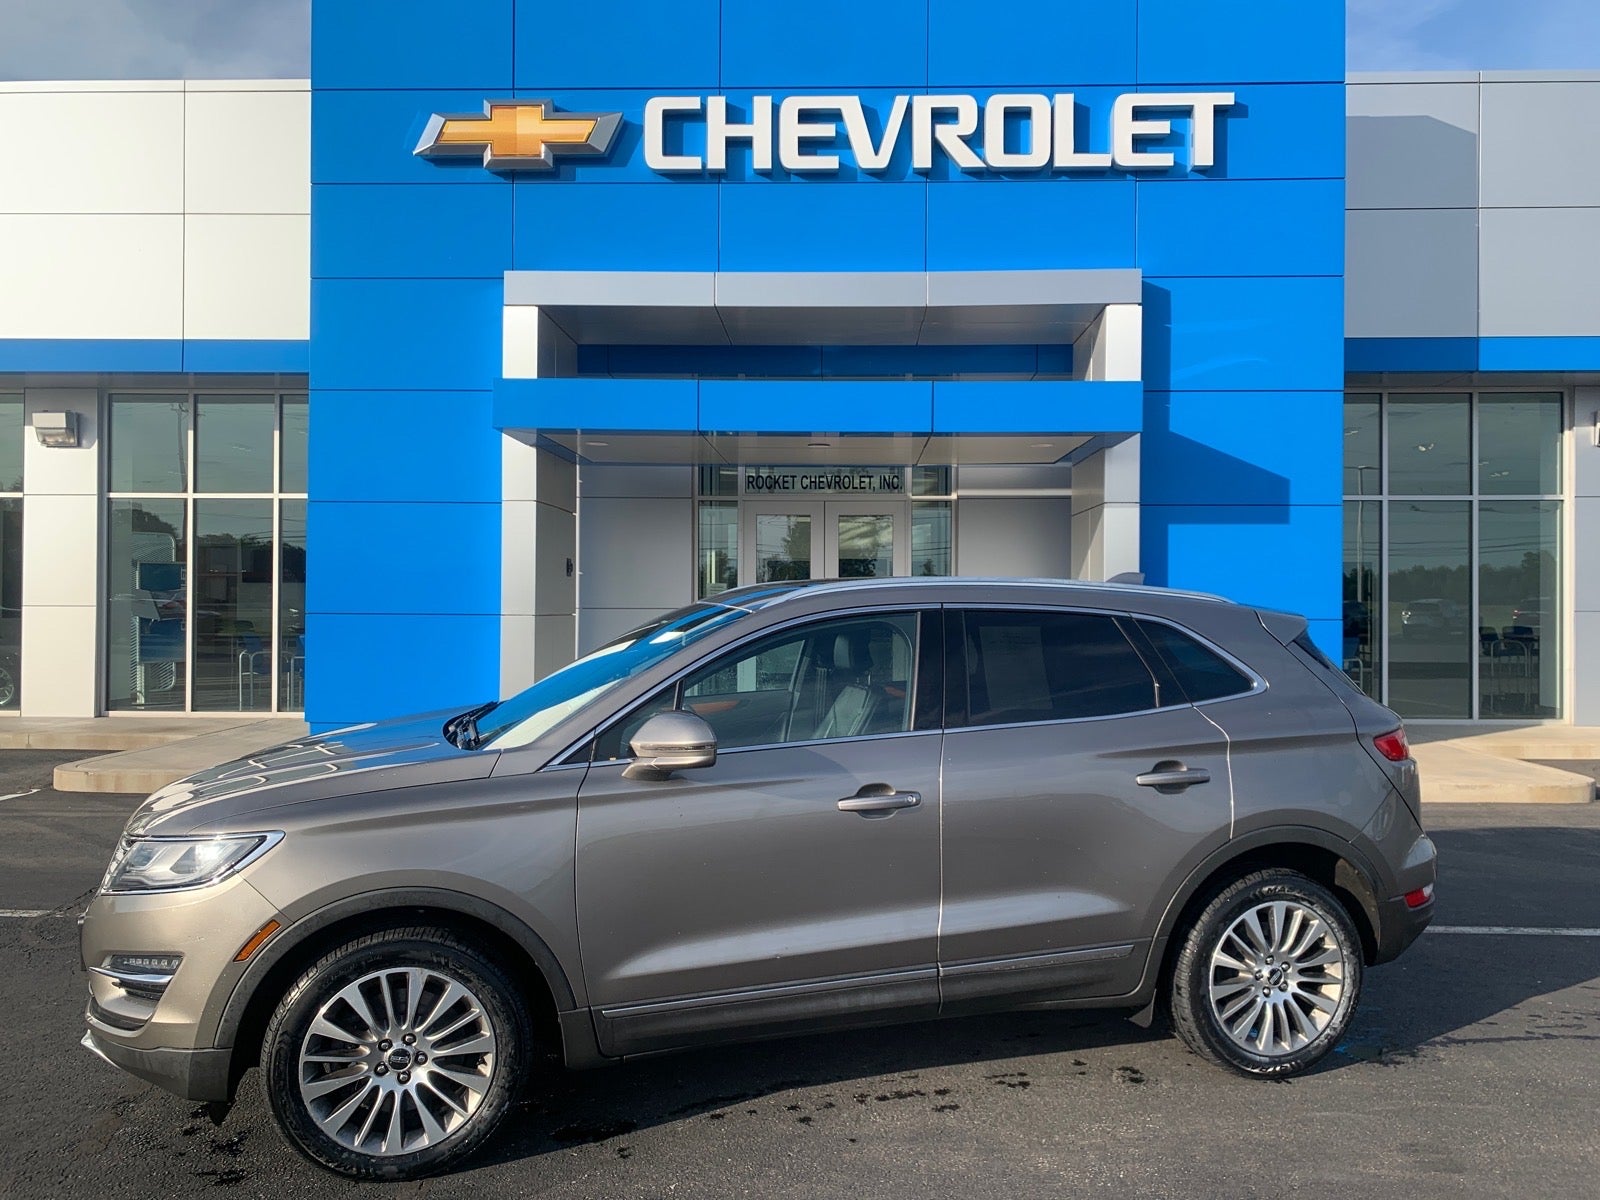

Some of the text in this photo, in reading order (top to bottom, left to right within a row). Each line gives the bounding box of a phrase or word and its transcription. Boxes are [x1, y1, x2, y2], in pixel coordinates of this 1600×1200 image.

[644, 92, 1235, 172] CHEVROLET
[747, 475, 903, 491] ROCKET CHEVROLET, INC.
